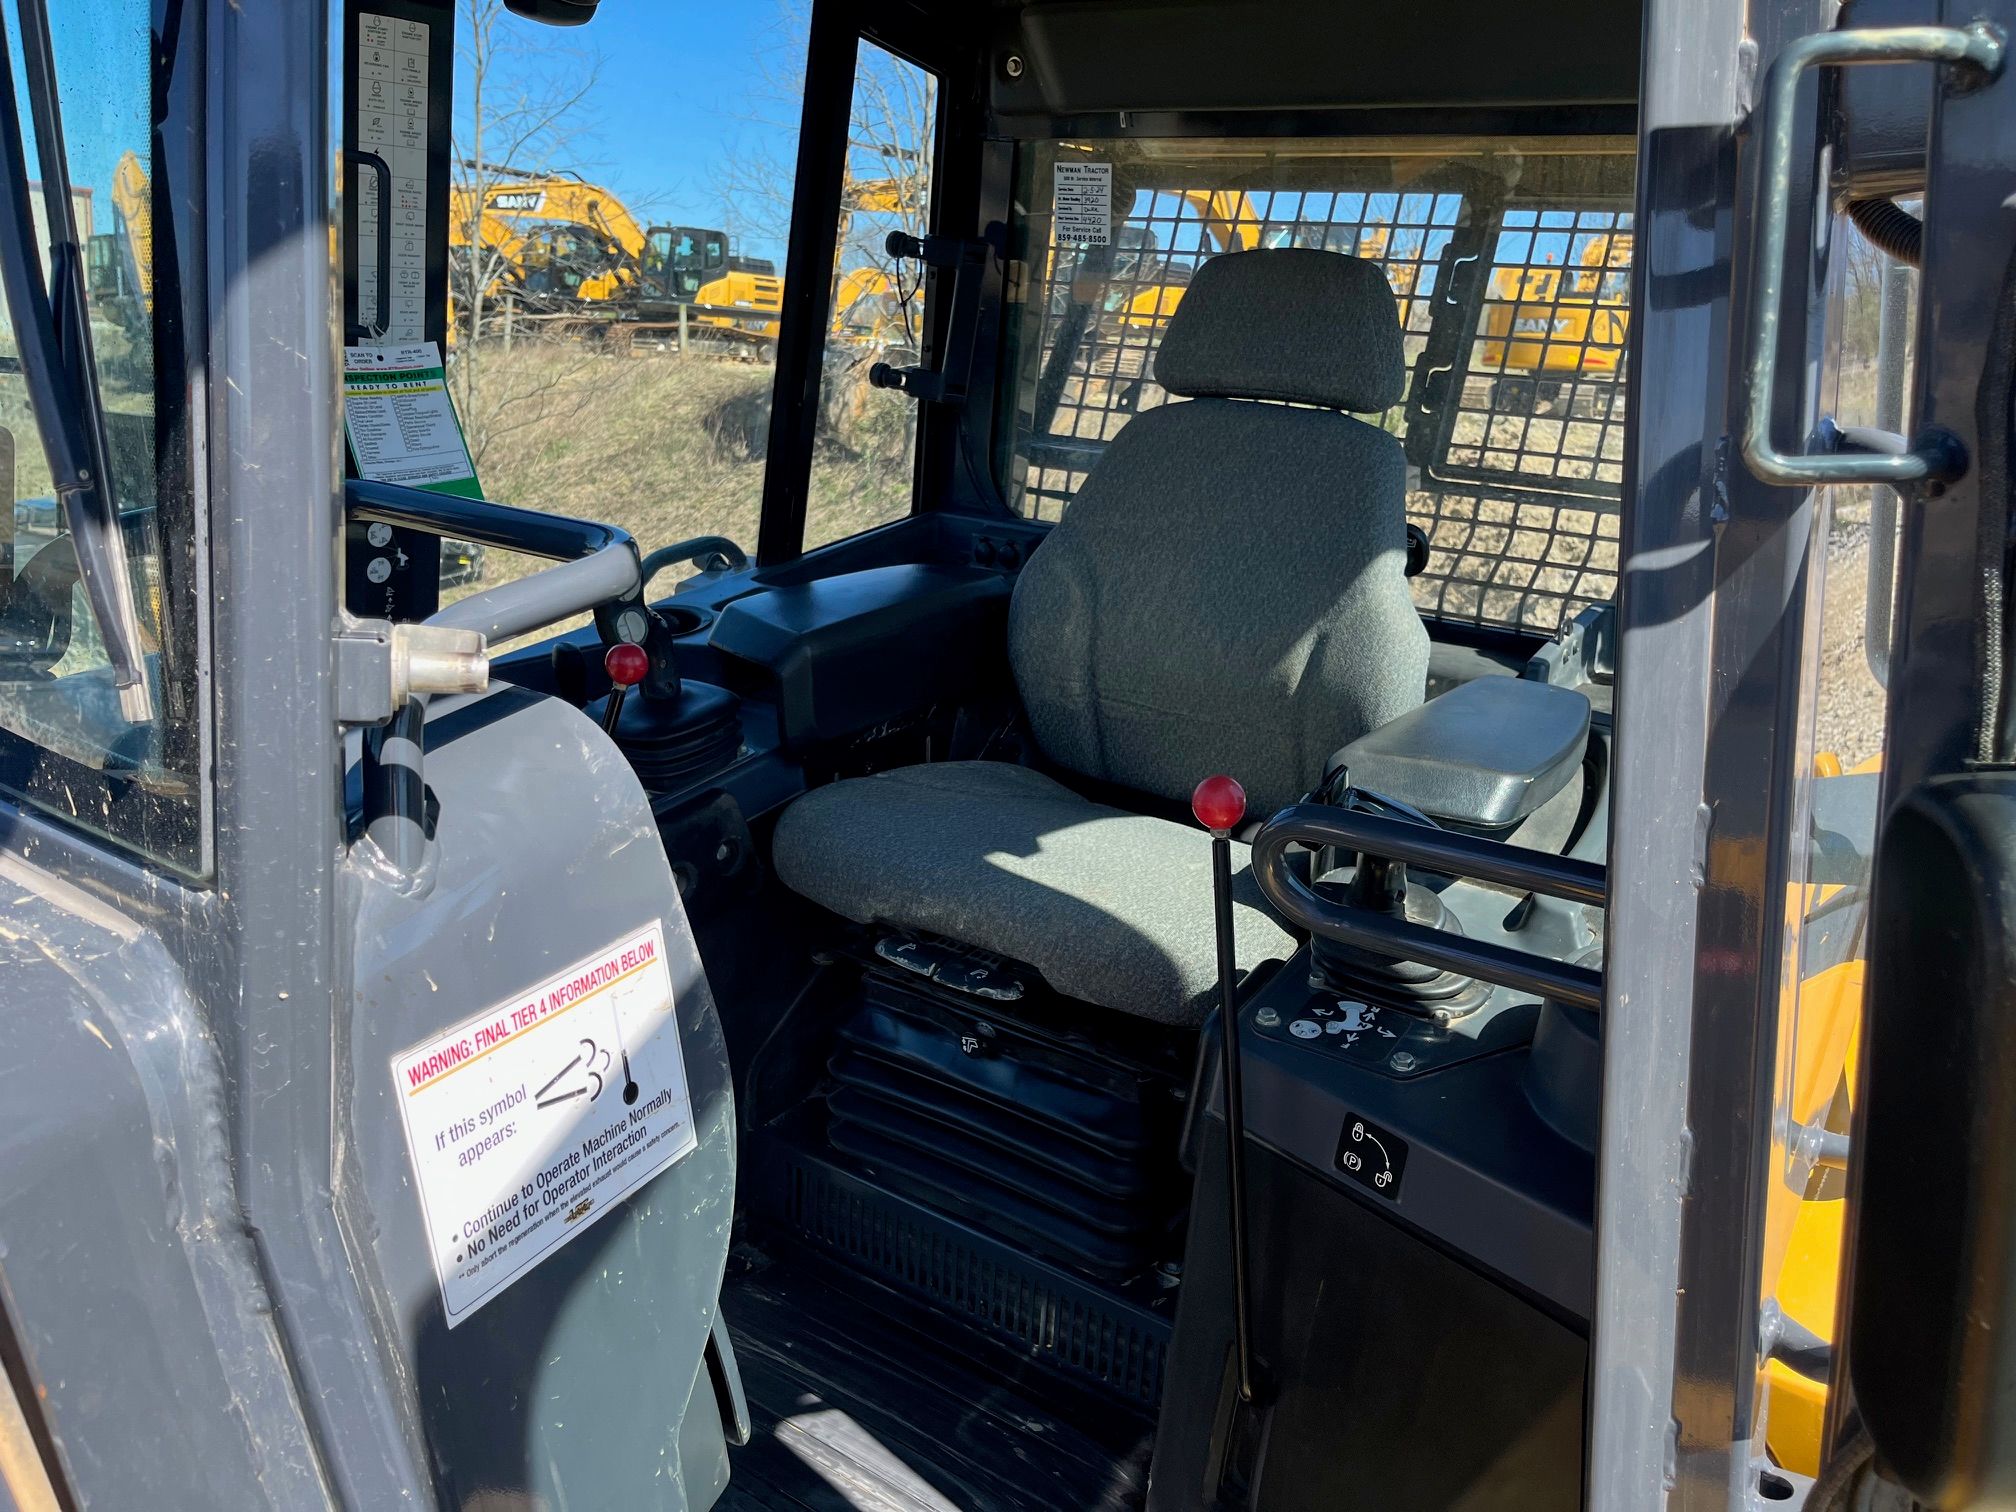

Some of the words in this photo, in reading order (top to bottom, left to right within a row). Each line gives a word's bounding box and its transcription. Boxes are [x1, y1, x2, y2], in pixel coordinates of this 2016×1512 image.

[1057, 165, 1081, 174] NEWMAN
[1084, 165, 1109, 174] TRACTOR
[1057, 234, 1107, 243] 859-485-8500
[1514, 318, 1569, 333] SANY
[408, 1039, 474, 1087] WARNING:
[474, 1019, 511, 1052] FINAL
[510, 1003, 538, 1031] TIER
[539, 998, 547, 1016] 4
[548, 959, 620, 1012] INFORMATION
[620, 939, 655, 972] BELOW
[435, 1131, 446, 1152] If
[448, 1117, 476, 1143] this
[479, 1083, 527, 1126] symbol
[458, 1121, 517, 1167] appears:
[463, 1193, 519, 1239] Continue
[521, 1183, 534, 1200] to
[536, 1151, 580, 1189] Operate
[582, 1120, 627, 1158] Machine
[629, 1088, 672, 1126] Normally
[467, 1238, 486, 1260] No
[488, 1210, 521, 1245] Need
[522, 1199, 540, 1221] for
[542, 1163, 590, 1206] Operator
[593, 1125, 647, 1172] Interaction
[466, 1263, 480, 1278] Only
[481, 1250, 498, 1268] abort
[497, 1243, 508, 1256] the
[508, 1219, 544, 1248] regeneration
[544, 1207, 560, 1222] when
[560, 1200, 569, 1211] the
[570, 1183, 591, 1203] elevated
[592, 1169, 612, 1188] exhaust
[612, 1159, 628, 1175] would
[628, 1148, 642, 1163] cause
[646, 1135, 661, 1150] safety
